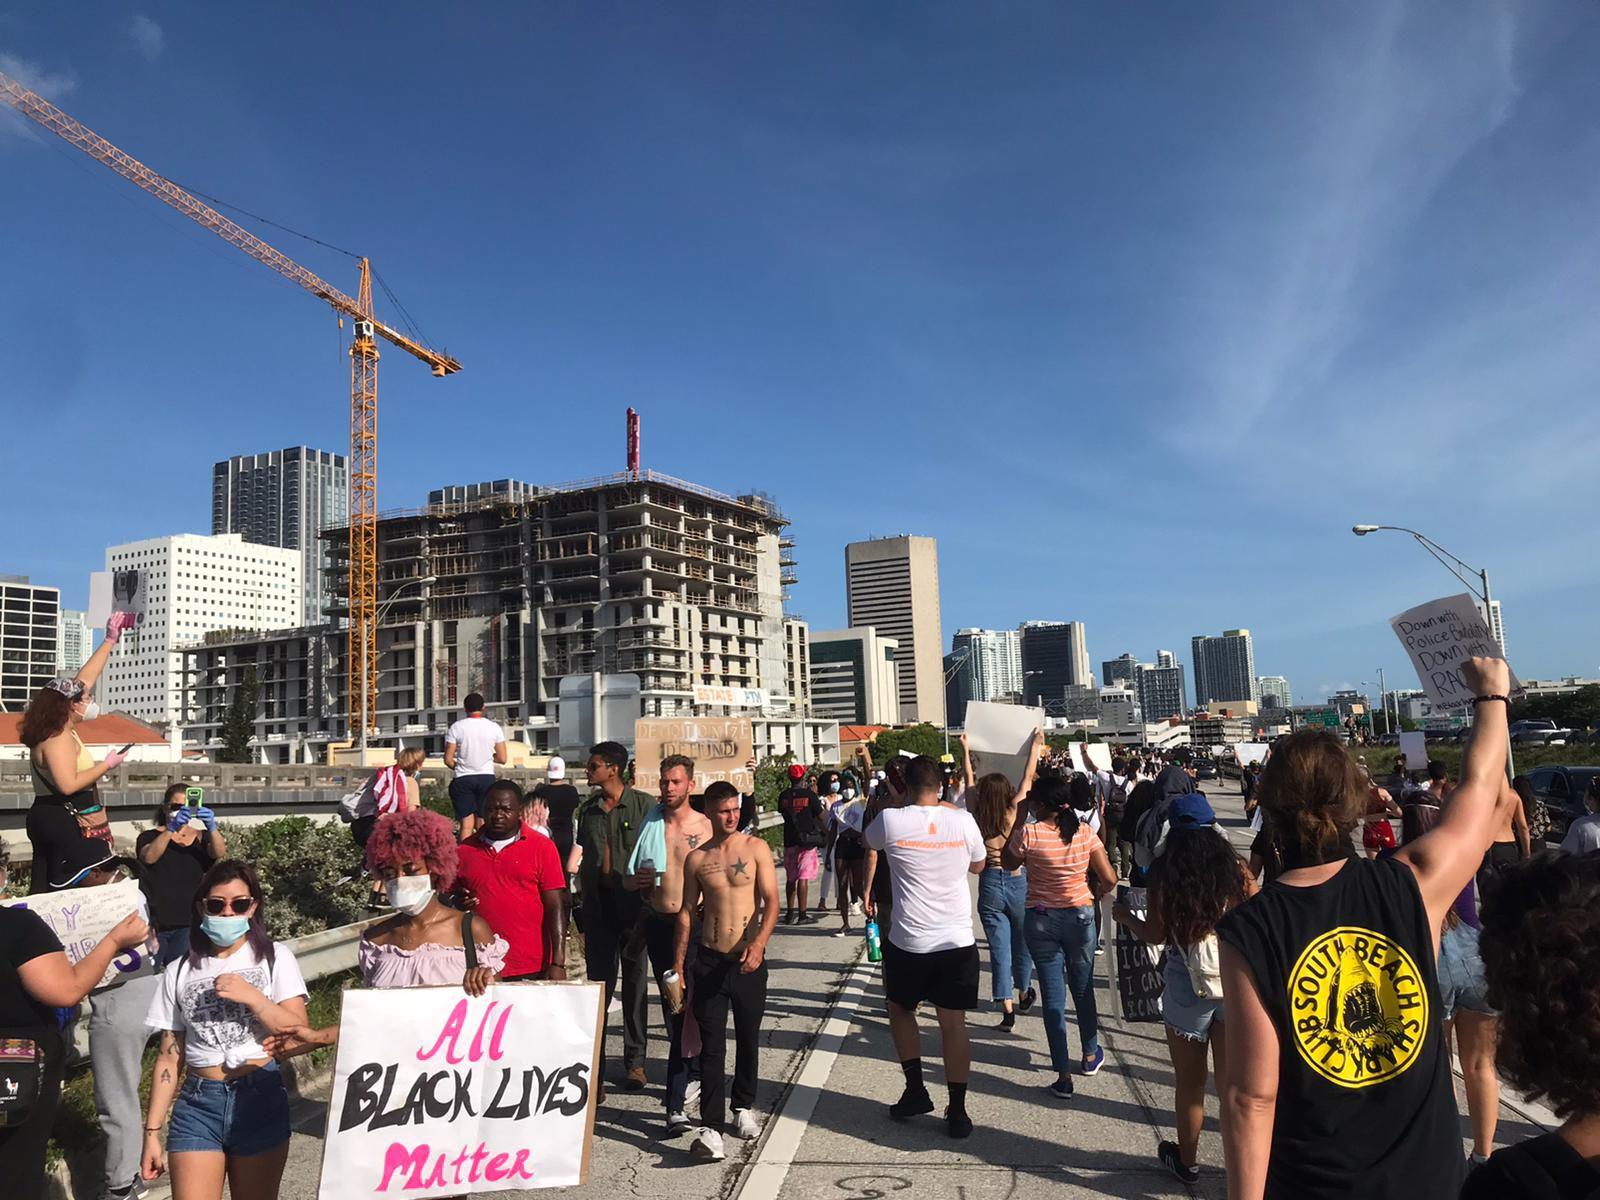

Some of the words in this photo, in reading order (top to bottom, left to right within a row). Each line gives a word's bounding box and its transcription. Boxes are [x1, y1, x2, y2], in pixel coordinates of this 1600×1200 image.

[1398, 617, 1437, 635] Down
[1437, 609, 1459, 624] with
[1406, 630, 1450, 650] Police
[1431, 666, 1468, 698] RAC
[1295, 938, 1344, 1011] SOUTH
[1354, 937, 1421, 1010] BEACH
[416, 998, 514, 1064] All
[1298, 1015, 1347, 1073] CLUB
[1354, 1015, 1420, 1078] SHARK
[338, 1062, 477, 1133] BLACK
[483, 1062, 590, 1121] LIVES
